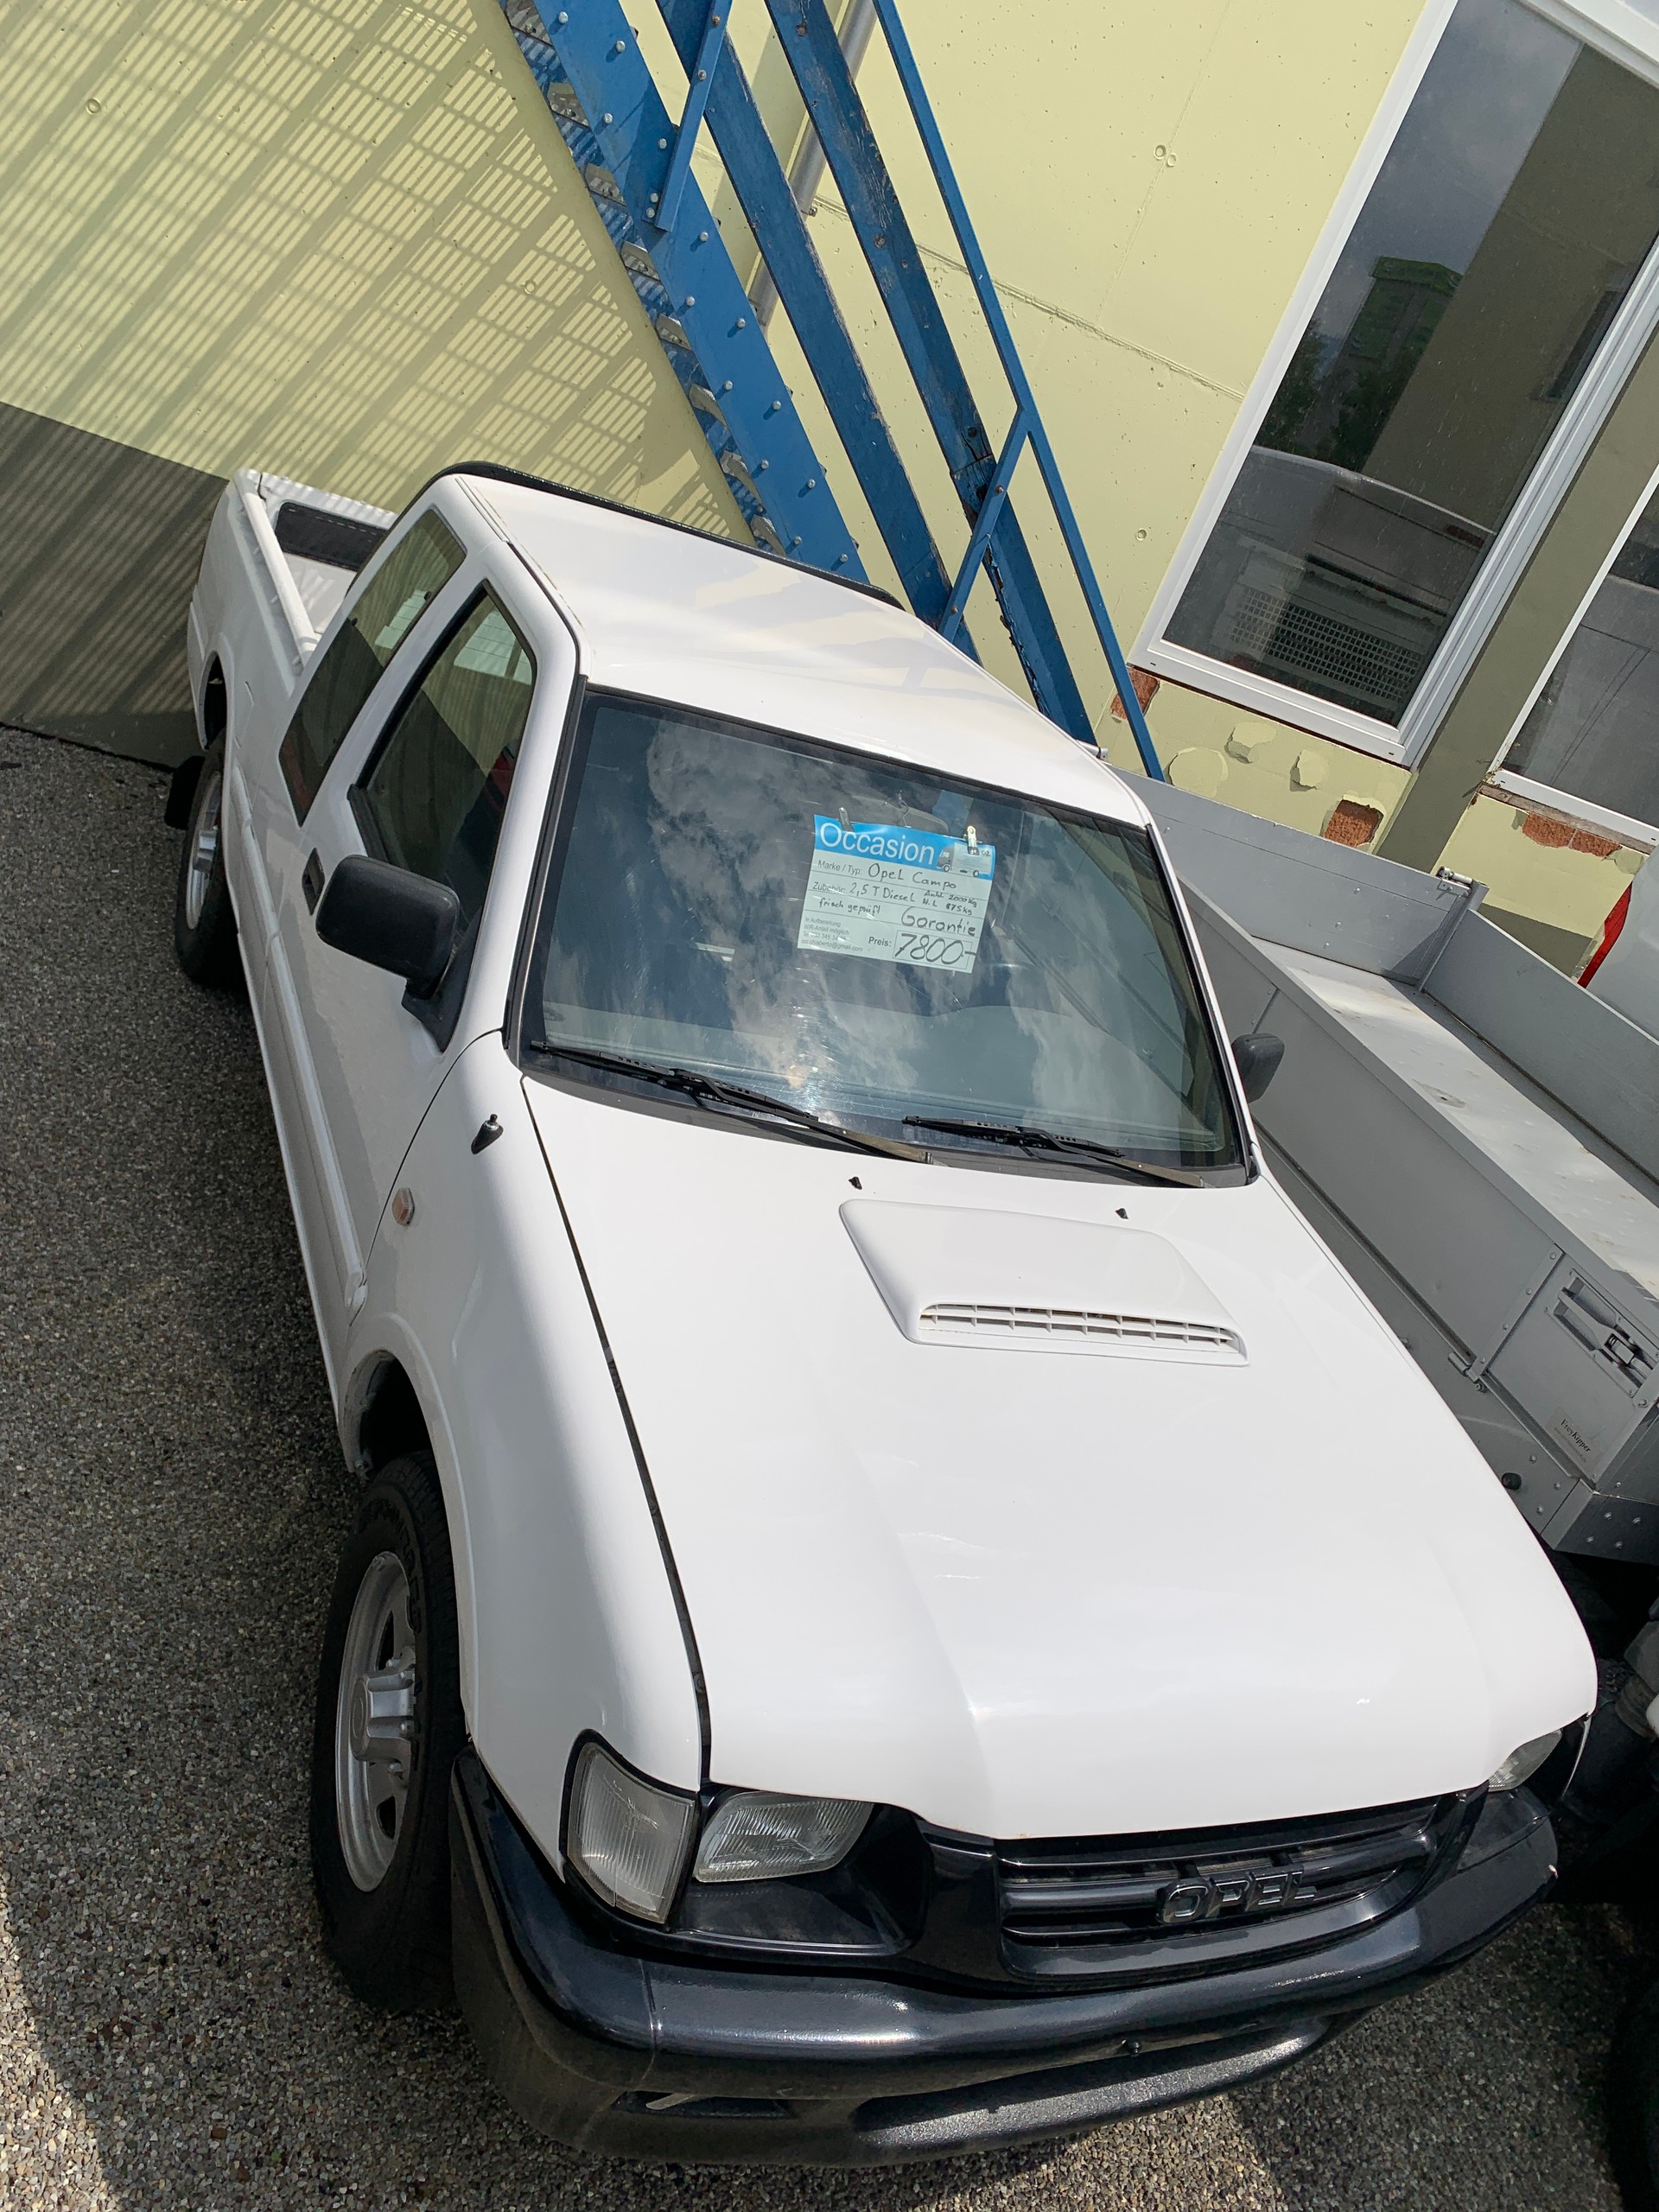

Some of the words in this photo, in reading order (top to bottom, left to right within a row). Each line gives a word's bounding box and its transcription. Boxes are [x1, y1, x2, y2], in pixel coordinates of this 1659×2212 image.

[820, 822, 934, 865] Occasion
[817, 860, 841, 872] Marke
[848, 865, 863, 876] Typ:
[868, 862, 904, 882] Opel
[912, 872, 957, 890] Campo
[819, 898, 843, 908] frisch
[849, 882, 869, 896] 2,5
[873, 886, 880, 896] T
[883, 887, 915, 902] Diesel
[901, 906, 976, 937] Garantie
[868, 936, 892, 947] Preis:
[1155, 1863, 1317, 1923] OPEL
